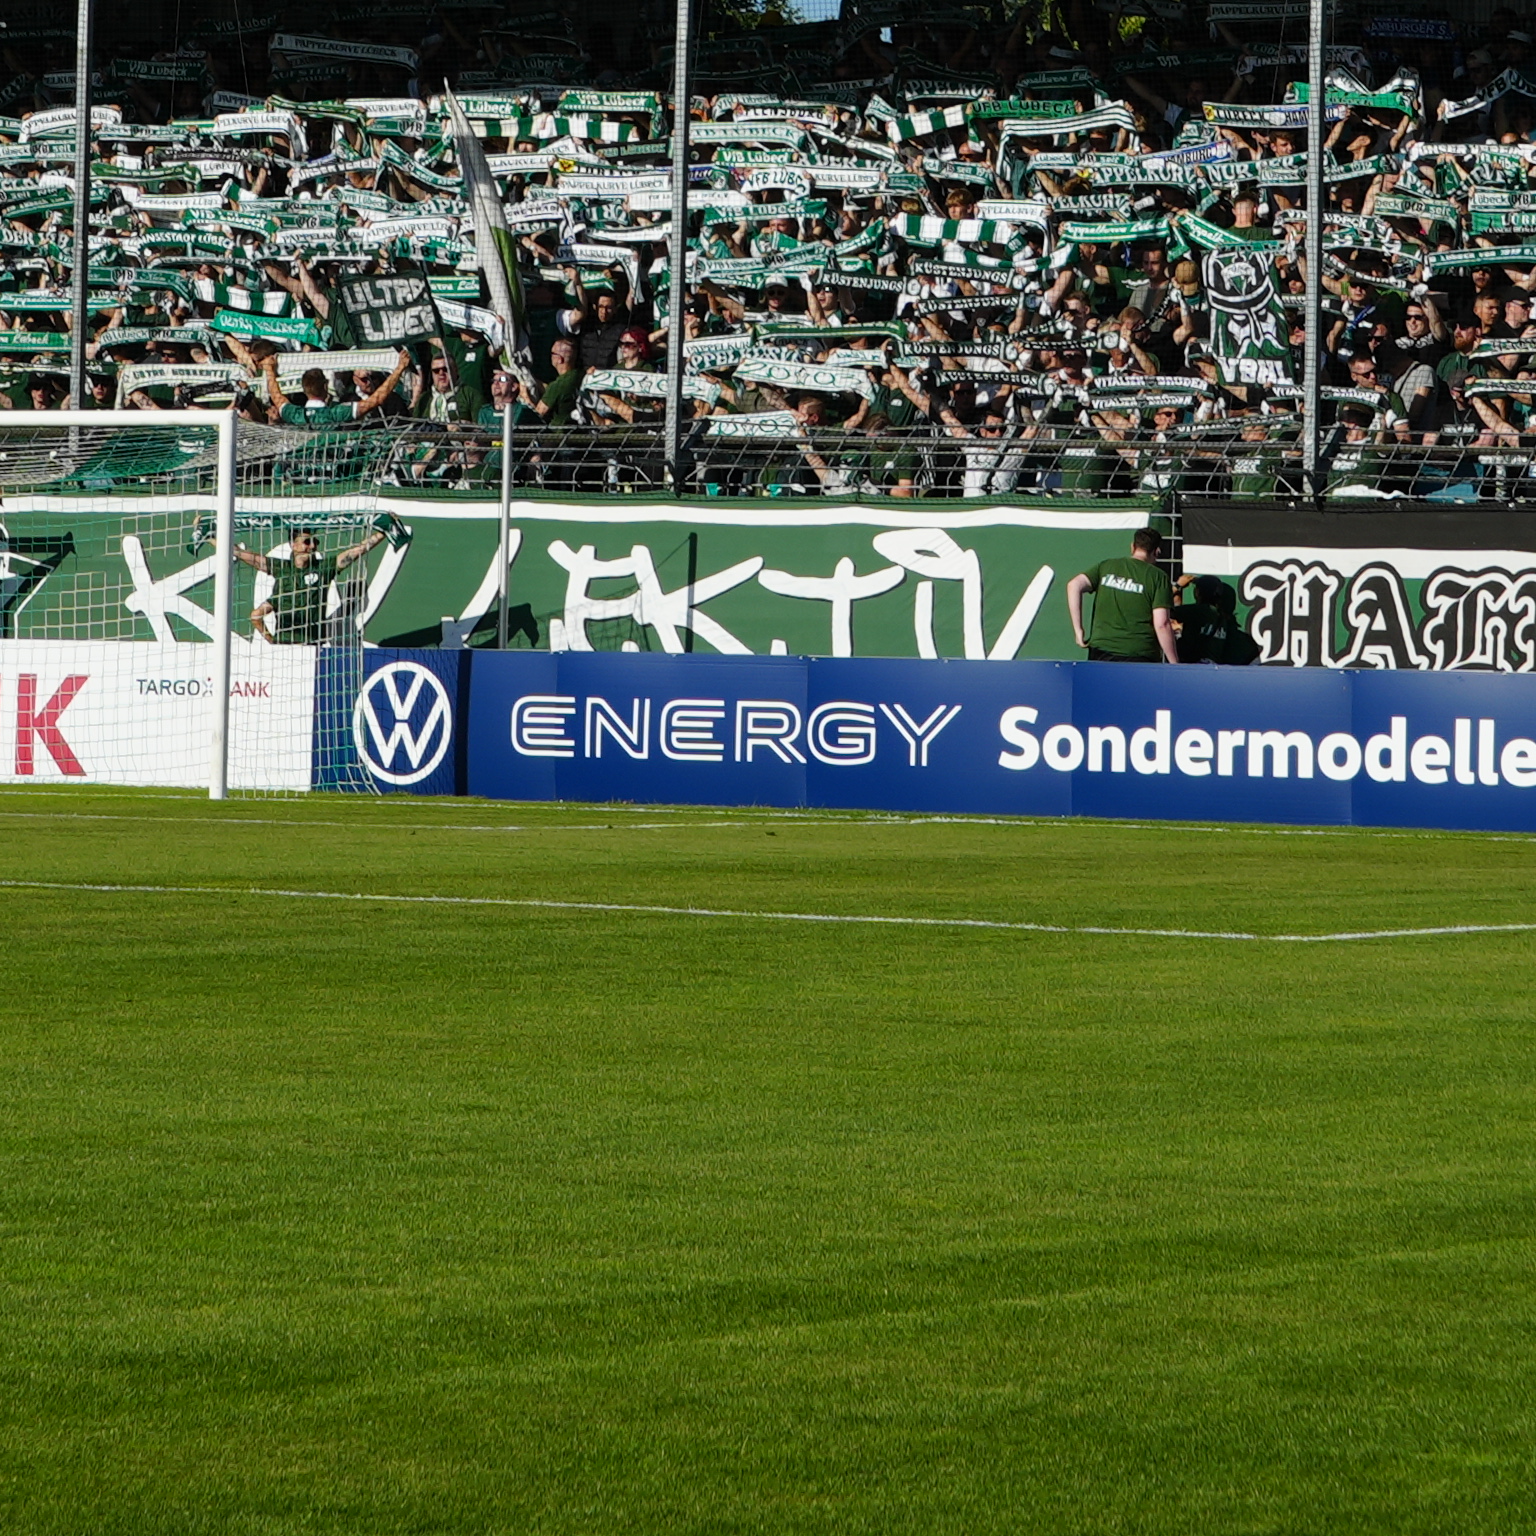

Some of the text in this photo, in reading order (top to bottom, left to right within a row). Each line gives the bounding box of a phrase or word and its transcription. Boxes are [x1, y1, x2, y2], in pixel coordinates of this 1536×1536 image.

[293, 38, 397, 58] PAPPELKURVE LÜBECK
[601, 96, 645, 109] Lübeck
[1009, 99, 1073, 117] LÜBECK
[722, 150, 792, 164] VfB Lübeck
[1207, 161, 1253, 181] NUR
[1473, 195, 1507, 209] Lübeck
[821, 271, 903, 292] KÜSTENJUNGS
[914, 260, 1009, 283] KÜSTENJUNGS
[918, 293, 1020, 315] KÜSTENJUNGS
[903, 341, 1000, 357] KÜSTENJUNGS
[939, 369, 1038, 389] KÜSTENJUNGS
[511, 695, 962, 767] ENERGY
